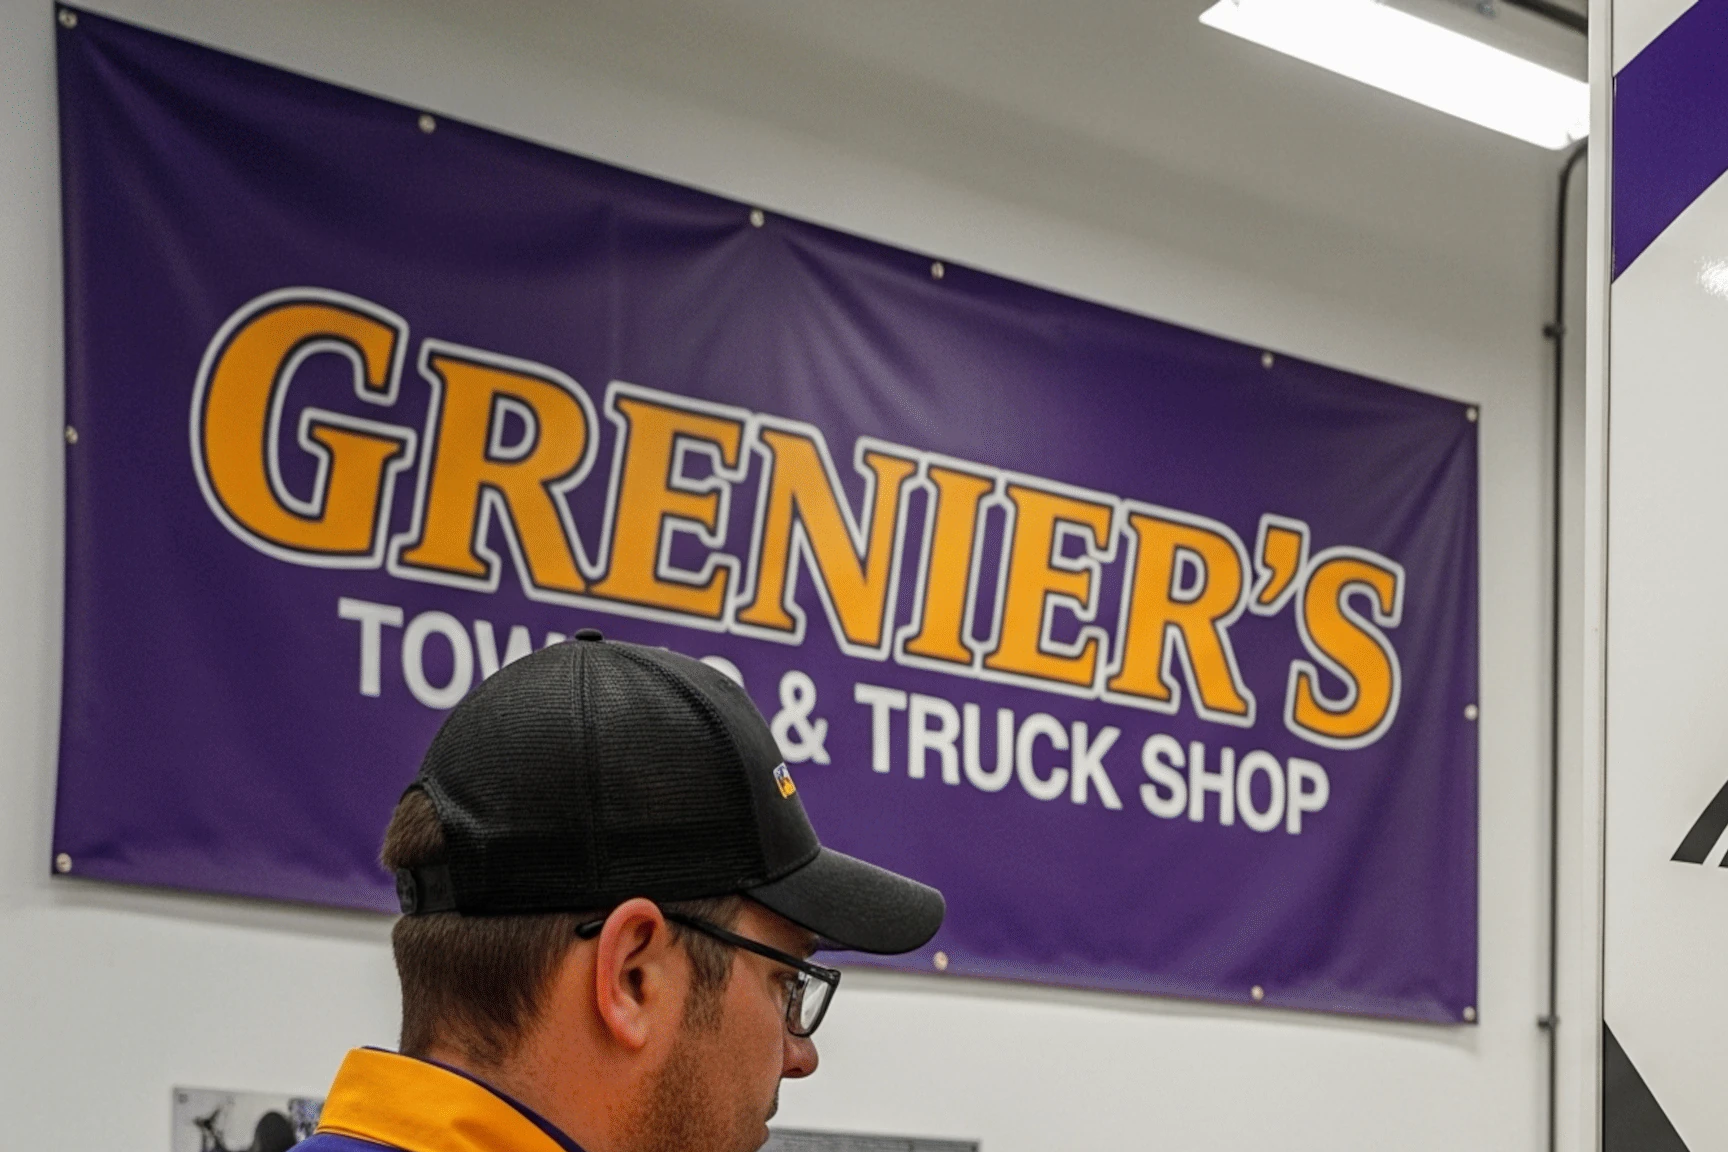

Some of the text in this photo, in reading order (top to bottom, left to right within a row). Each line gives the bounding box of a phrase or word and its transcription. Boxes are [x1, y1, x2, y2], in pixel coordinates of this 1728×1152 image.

[190, 286, 1405, 750] GRENIER'S
[771, 671, 831, 766] &
[854, 683, 1123, 810] TRUCK
[1140, 734, 1330, 835] SHOP
